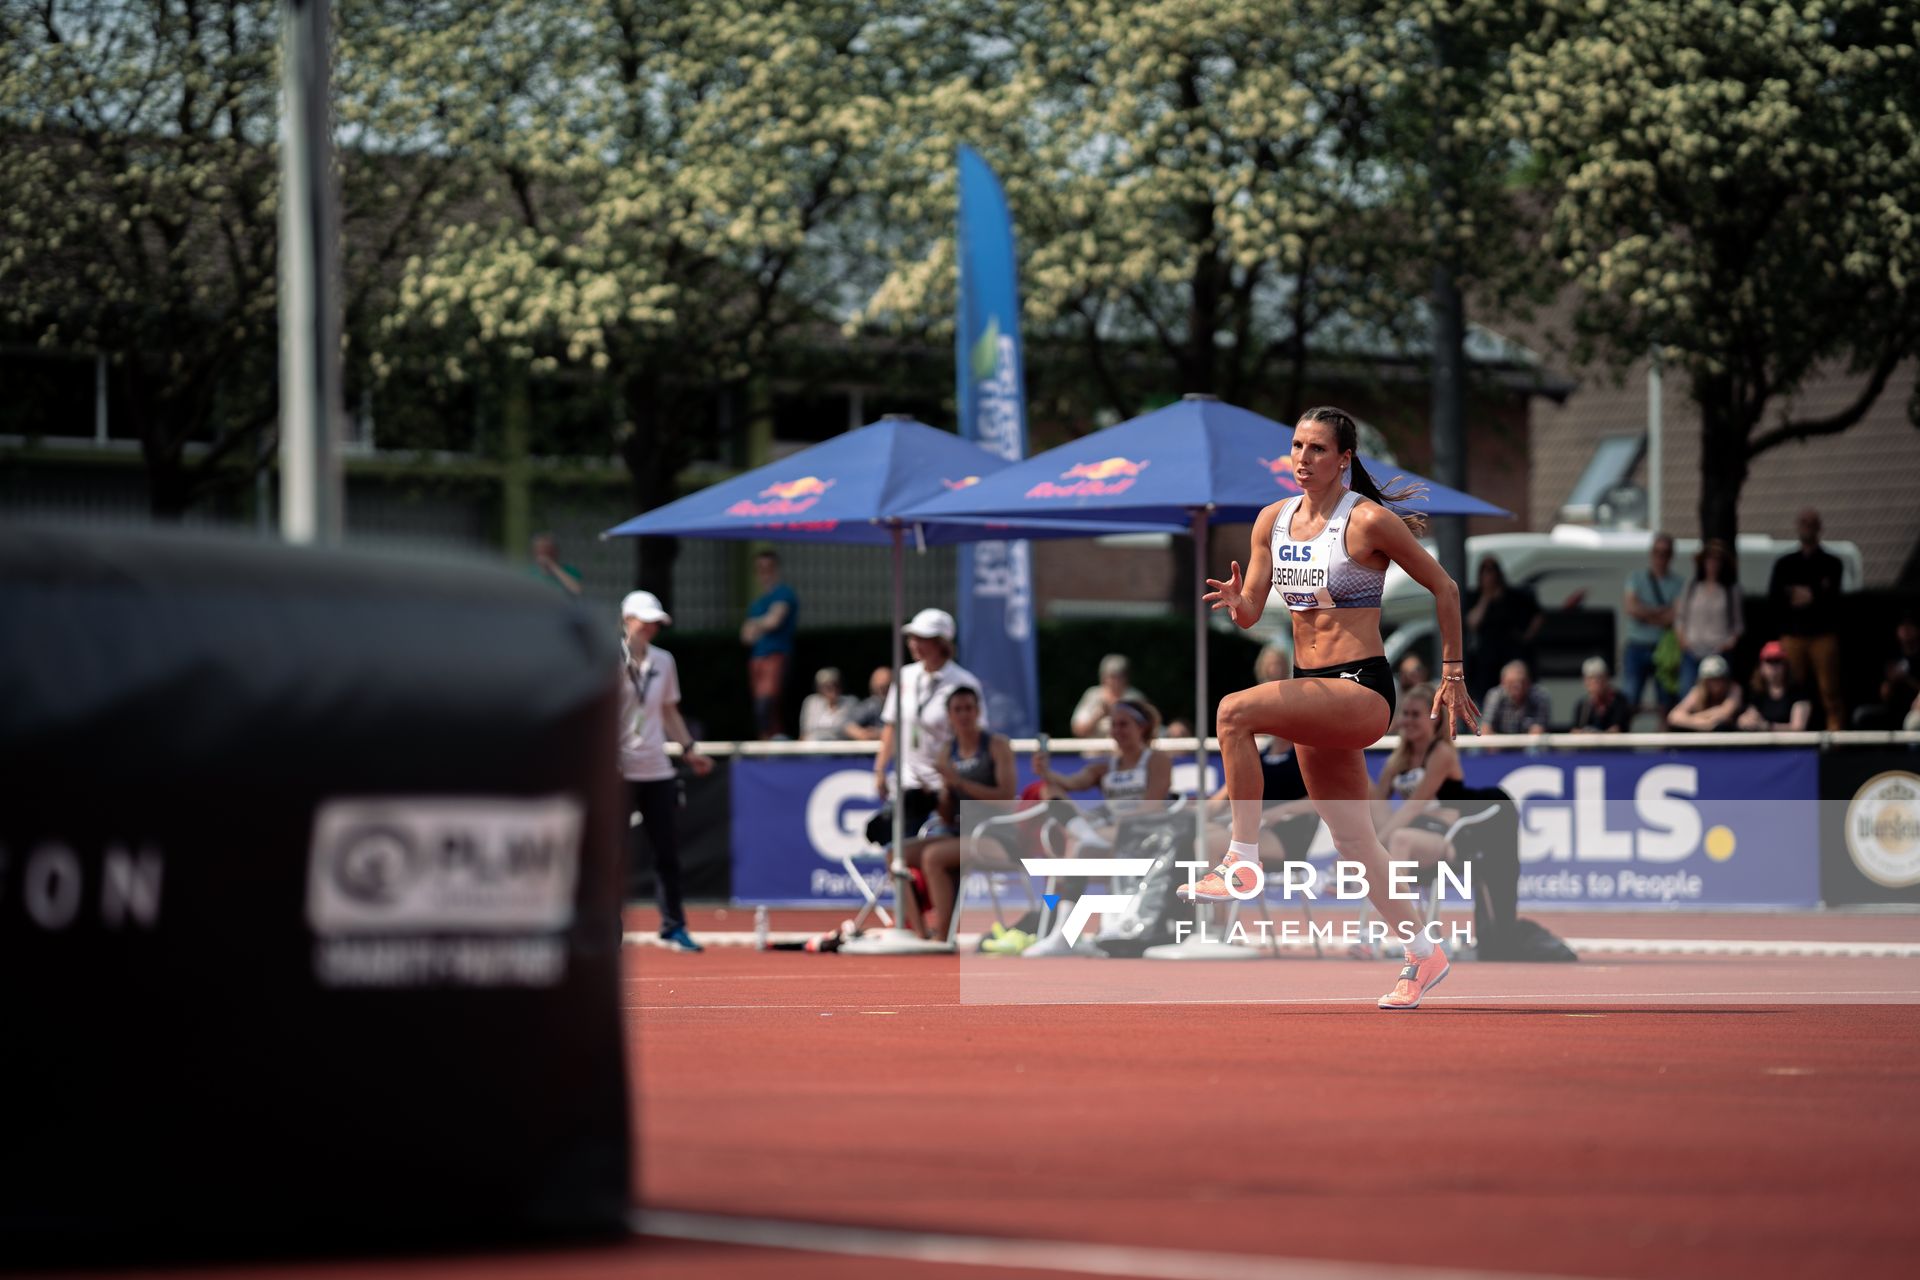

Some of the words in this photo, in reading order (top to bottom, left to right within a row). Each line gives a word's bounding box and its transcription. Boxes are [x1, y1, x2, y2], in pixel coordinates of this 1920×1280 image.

[0, 842, 163, 931] ON
[1517, 868, 1582, 897] arcels
[1587, 872, 1615, 897] to
[1617, 868, 1703, 902] People
